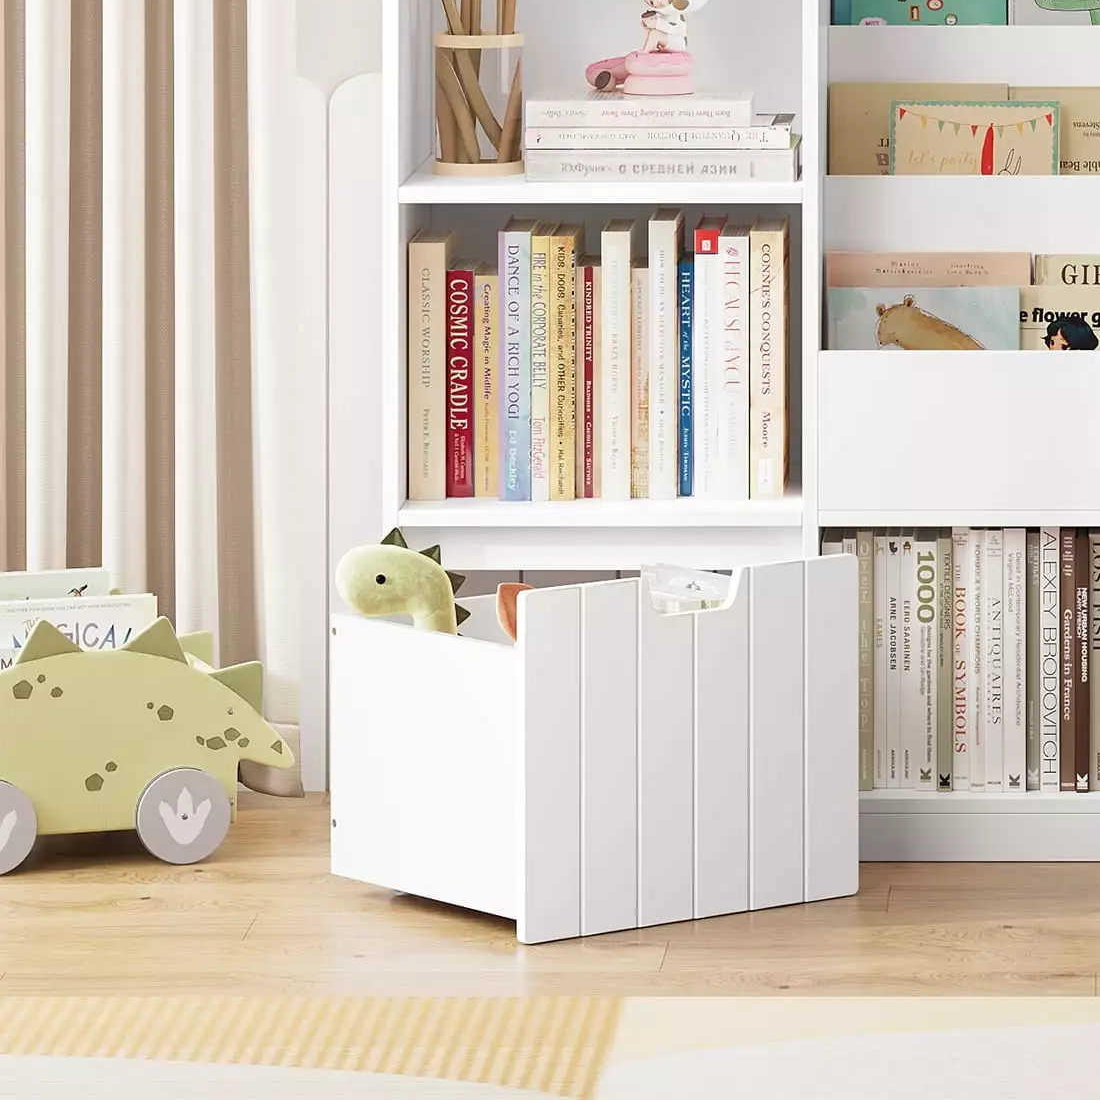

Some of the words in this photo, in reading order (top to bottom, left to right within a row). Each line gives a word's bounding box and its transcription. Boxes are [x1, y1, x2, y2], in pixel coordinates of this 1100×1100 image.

[1073, 122, 1100, 130] Stevens
[633, 161, 695, 175] СРЕДНЕЙ
[701, 164, 737, 174] АЗИИ
[508, 245, 520, 296] DANCE
[532, 252, 546, 270] FIRE
[532, 273, 546, 283] in
[761, 243, 771, 309] CONNIE'S
[421, 268, 430, 323] CLASSIC
[482, 284, 491, 323] Creating
[508, 301, 520, 321] OF
[532, 285, 546, 299] the
[585, 281, 593, 323] KINDRED
[681, 272, 690, 327] HEART
[449, 279, 468, 349] COSMIC
[508, 326, 520, 336] A
[532, 302, 546, 358] CORPORATE
[421, 327, 430, 388] WORSHIP
[482, 326, 491, 353] Magic
[557, 345, 565, 360] and
[585, 324, 593, 362] TRINITY
[760, 311, 771, 395] CONQUESTS
[484, 356, 491, 365] in
[508, 342, 520, 377] RICH
[532, 361, 546, 389] BELLY
[557, 364, 565, 392] OTHER
[449, 356, 468, 430] CRADLE
[483, 367, 491, 399] Midlife
[508, 383, 520, 419] YOGI
[681, 356, 690, 417] MYSTIC
[532, 416, 546, 435] Tom
[557, 395, 565, 437] Curiosities
[762, 412, 771, 448] Moore
[509, 430, 518, 444] Ed
[507, 448, 519, 491] Beckley
[917, 551, 935, 623] 1000
[1043, 531, 1057, 618] ALEXEY
[955, 587, 966, 638] BOOK
[955, 644, 961, 656] OF
[1064, 609, 1072, 660] Gardens
[990, 597, 1001, 725] ANTIQUAIRES
[1064, 663, 1072, 674] in
[955, 660, 966, 753] SYMBOLS
[1043, 628, 1057, 774] BRODOVITCH
[1064, 679, 1072, 720] France
